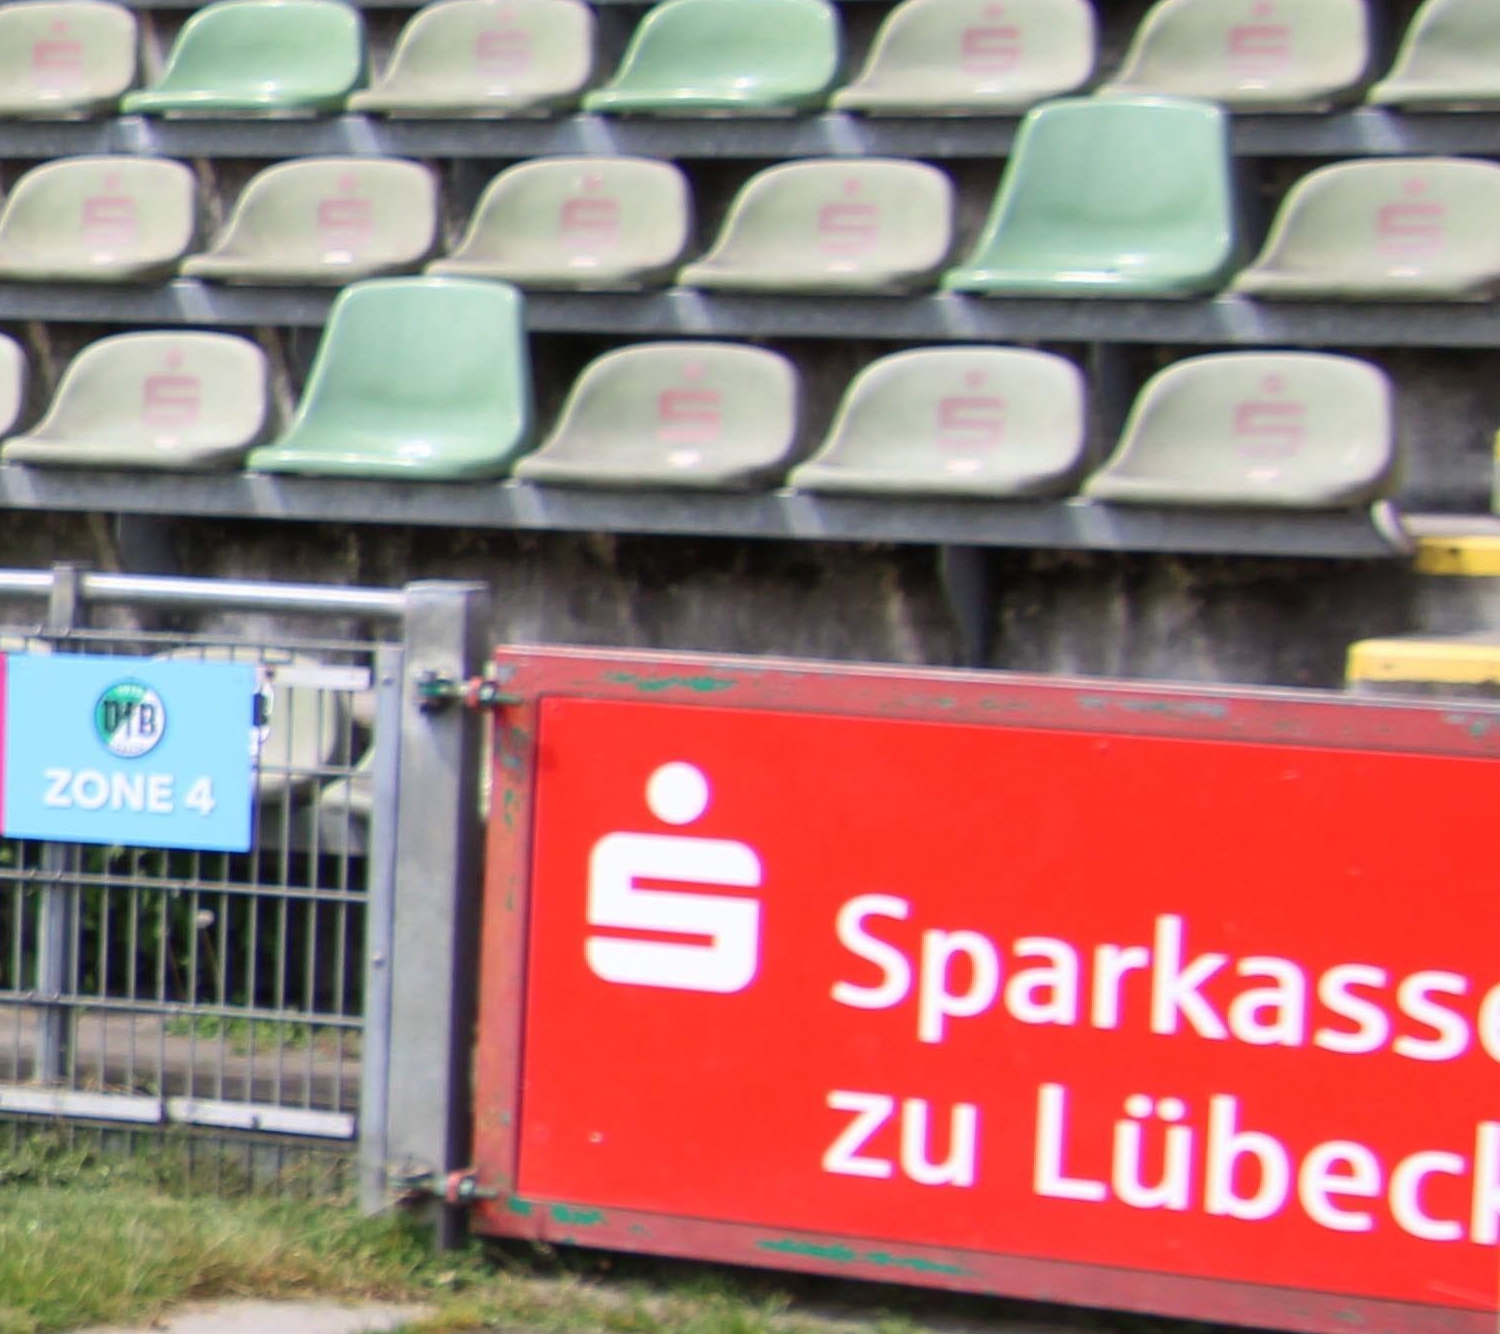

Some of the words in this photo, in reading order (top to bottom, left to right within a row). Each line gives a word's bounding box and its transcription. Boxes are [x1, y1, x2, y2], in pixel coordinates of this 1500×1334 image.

[44, 768, 175, 814] ZONE
[185, 775, 216, 816] 4
[821, 1088, 978, 1188] zu
